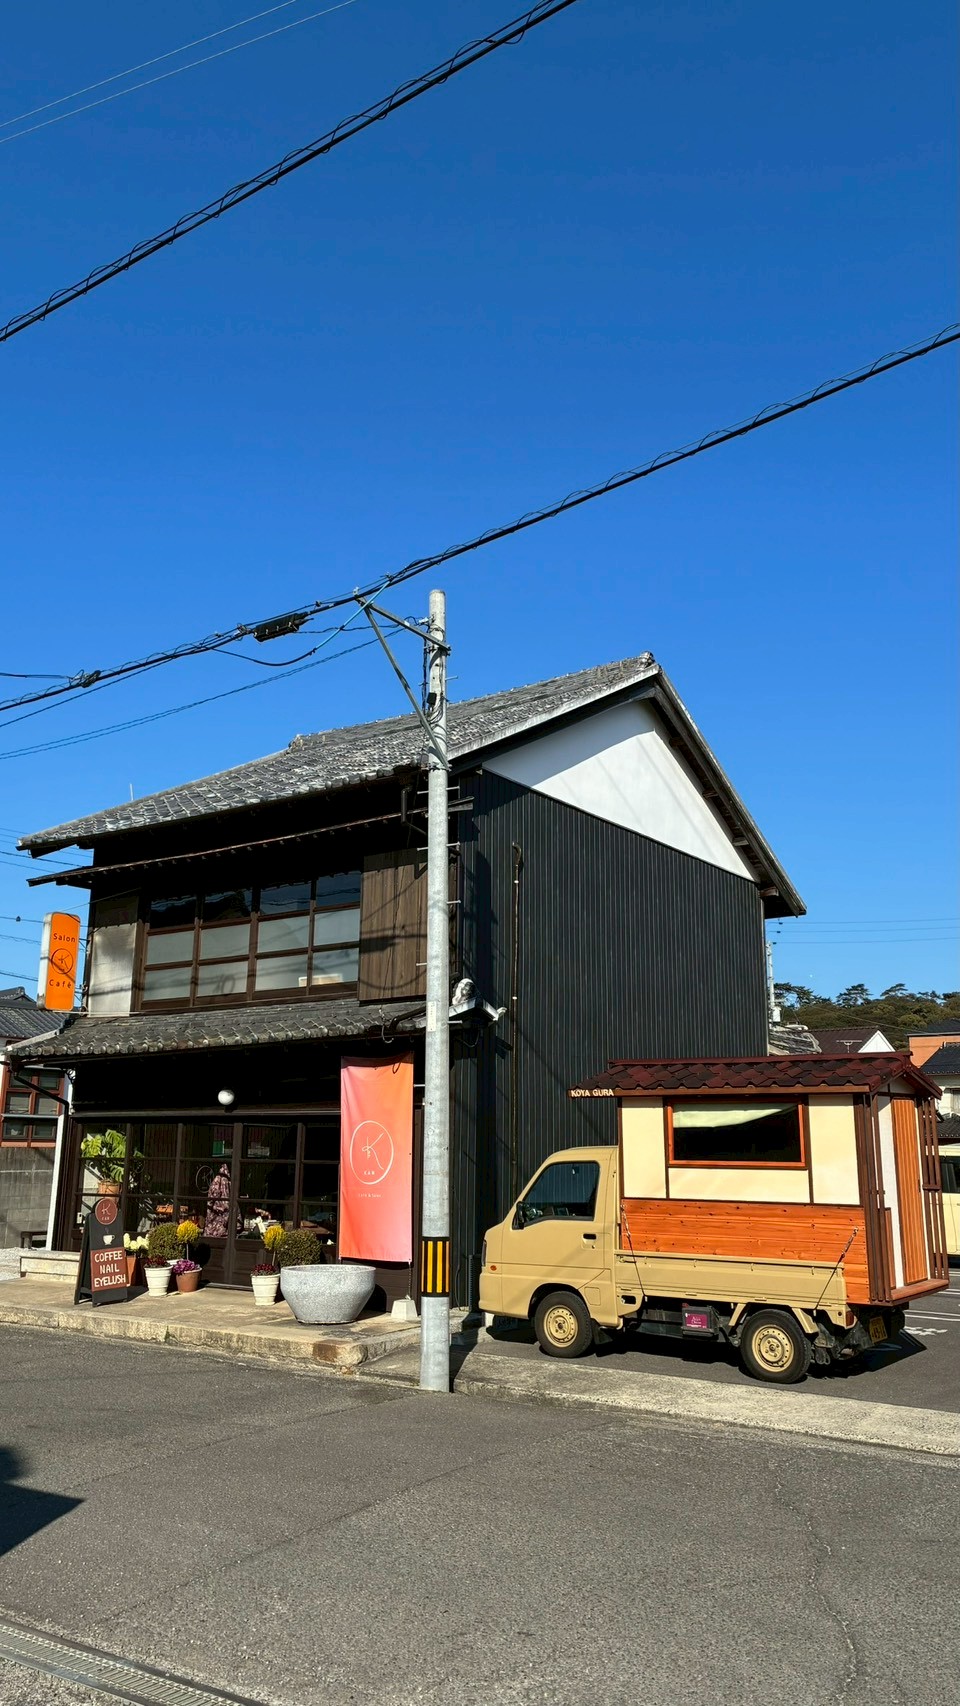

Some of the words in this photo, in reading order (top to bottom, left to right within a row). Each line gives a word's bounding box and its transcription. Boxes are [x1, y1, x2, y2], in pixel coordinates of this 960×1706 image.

[53, 932, 76, 943] Salon
[570, 1089, 591, 1097] KOYA
[592, 1088, 614, 1097] GURA
[362, 1132, 384, 1170] K
[101, 1203, 111, 1216] K
[94, 1250, 123, 1263] COFFEE
[99, 1263, 120, 1275] NAIL
